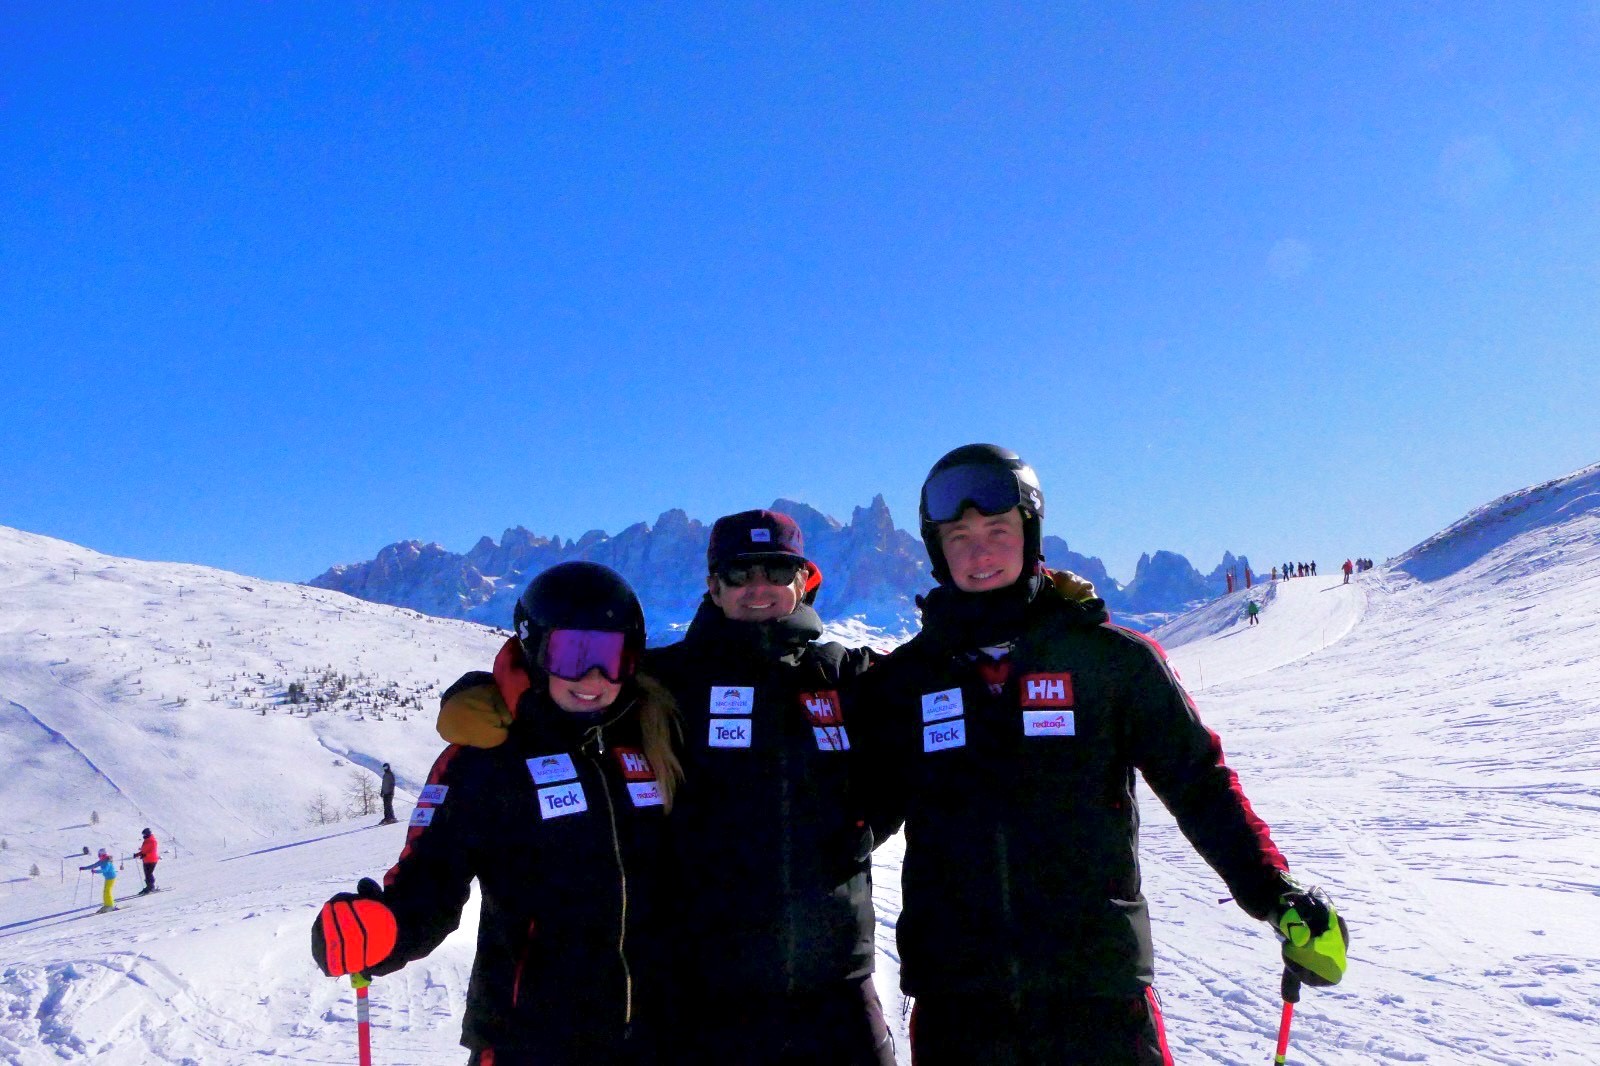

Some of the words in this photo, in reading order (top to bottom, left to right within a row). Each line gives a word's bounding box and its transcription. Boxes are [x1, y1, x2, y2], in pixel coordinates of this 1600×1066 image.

[1027, 679, 1065, 700] HH
[806, 698, 834, 717] HH
[715, 725, 745, 740] Teck
[928, 727, 960, 744] Teck
[621, 753, 650, 772] HH
[545, 790, 580, 810] Teck
